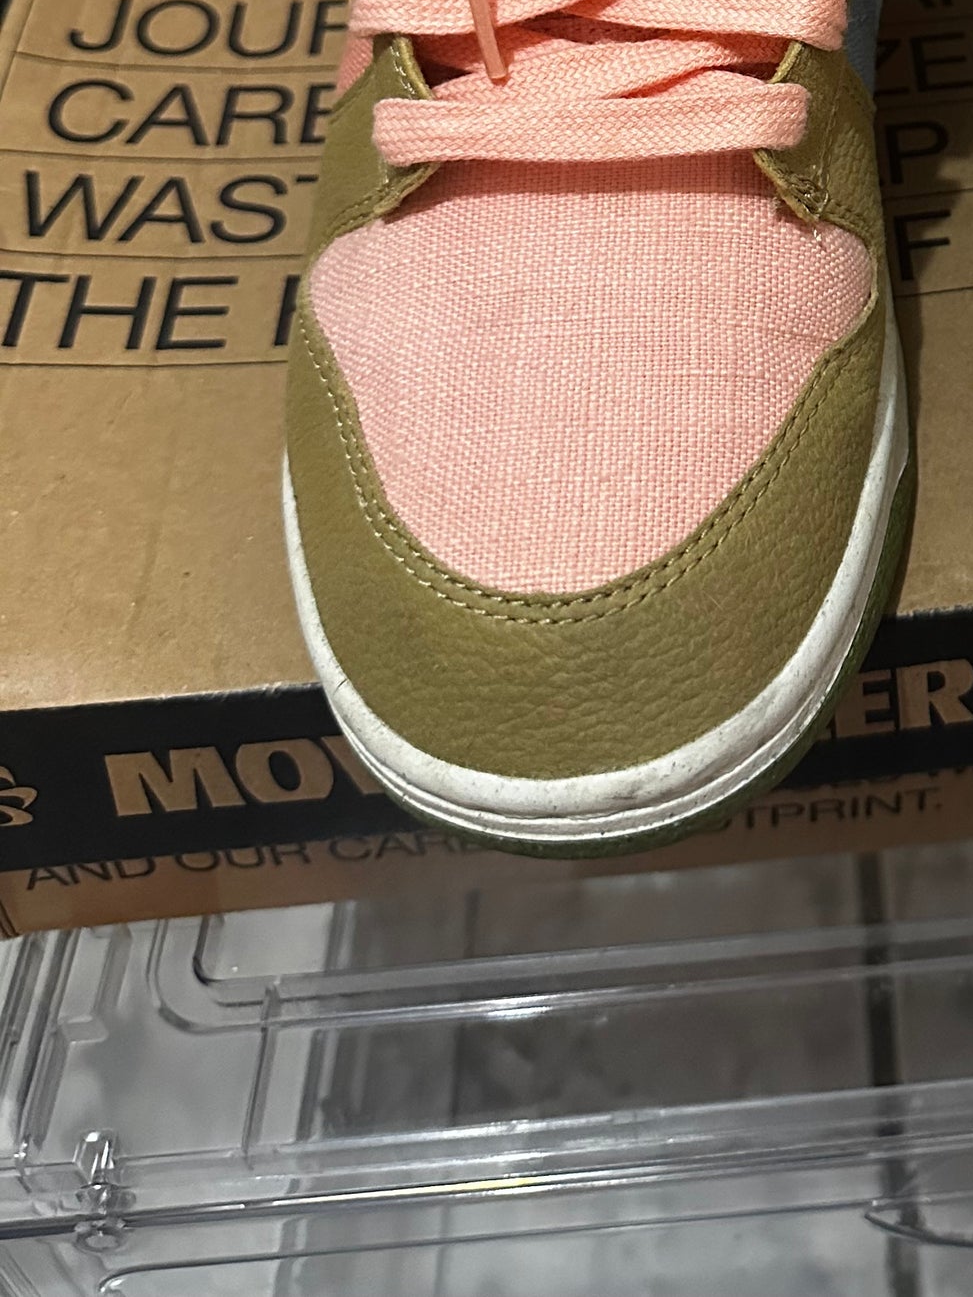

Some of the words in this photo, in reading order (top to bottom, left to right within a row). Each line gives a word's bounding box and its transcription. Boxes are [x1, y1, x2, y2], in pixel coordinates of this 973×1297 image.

[25, 169, 318, 243] WAS
[0, 269, 238, 350] THE
[26, 858, 156, 890] AND
[176, 843, 311, 870] OUR
[330, 832, 485, 862] CAR
[706, 787, 942, 830] TPRINT.
